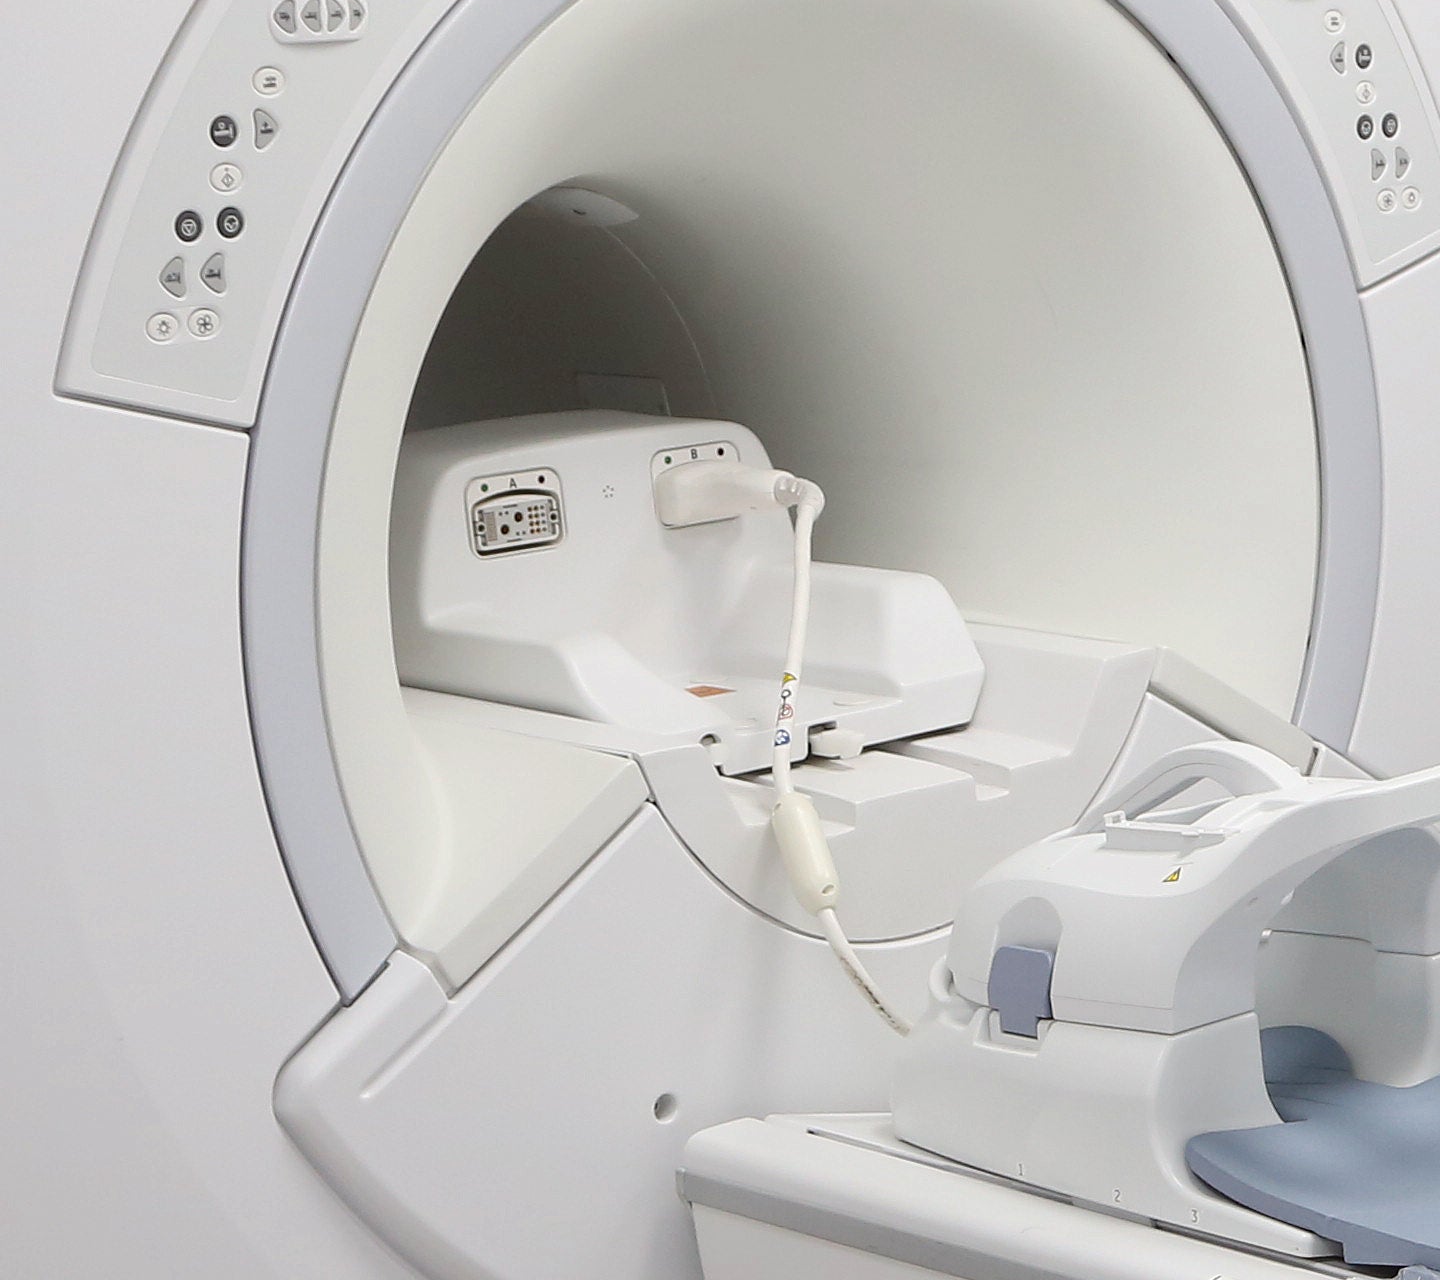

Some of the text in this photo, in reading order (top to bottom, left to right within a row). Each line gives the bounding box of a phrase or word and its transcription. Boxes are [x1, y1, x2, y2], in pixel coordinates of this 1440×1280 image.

[690, 448, 698, 460] B
[509, 478, 518, 489] A
[1113, 1189, 1121, 1203] 2
[1191, 1209, 1199, 1223] 3
